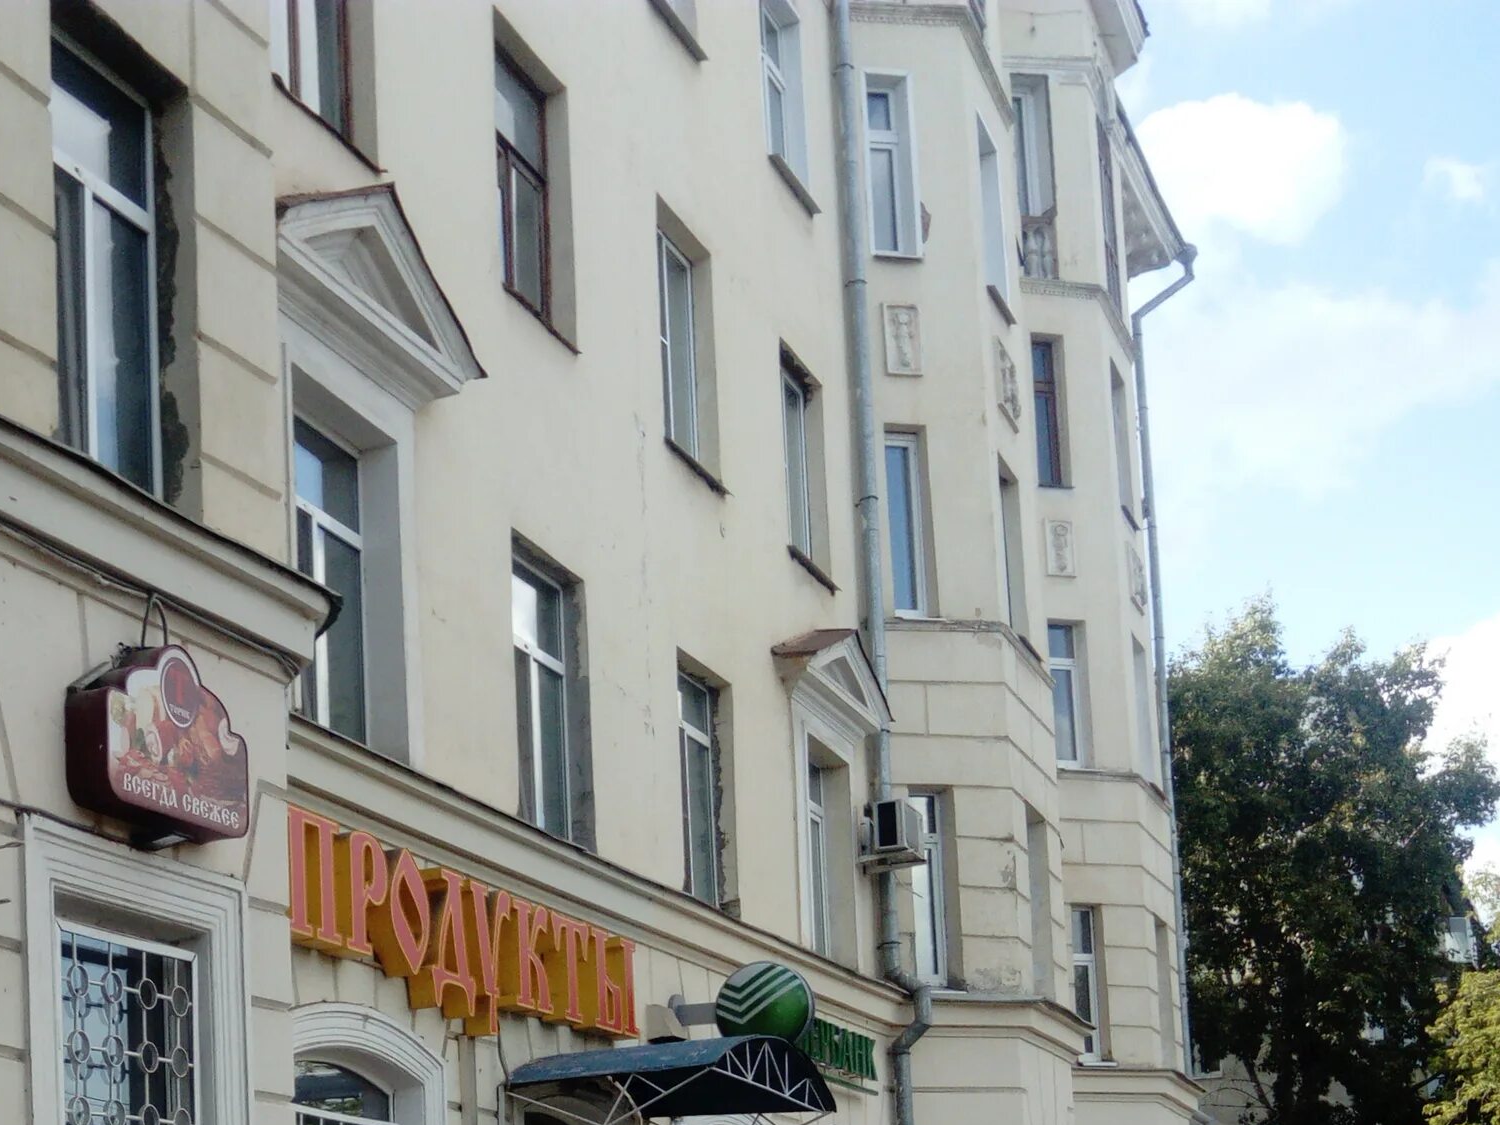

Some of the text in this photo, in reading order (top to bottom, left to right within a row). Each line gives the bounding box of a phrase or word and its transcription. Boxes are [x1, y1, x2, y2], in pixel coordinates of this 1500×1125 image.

[123, 772, 240, 829] ВСЕГДА СВЕЖЕЕ
[288, 803, 640, 1037] ПРОДУКТЫ
[803, 1017, 879, 1081] ЕРБАНК
